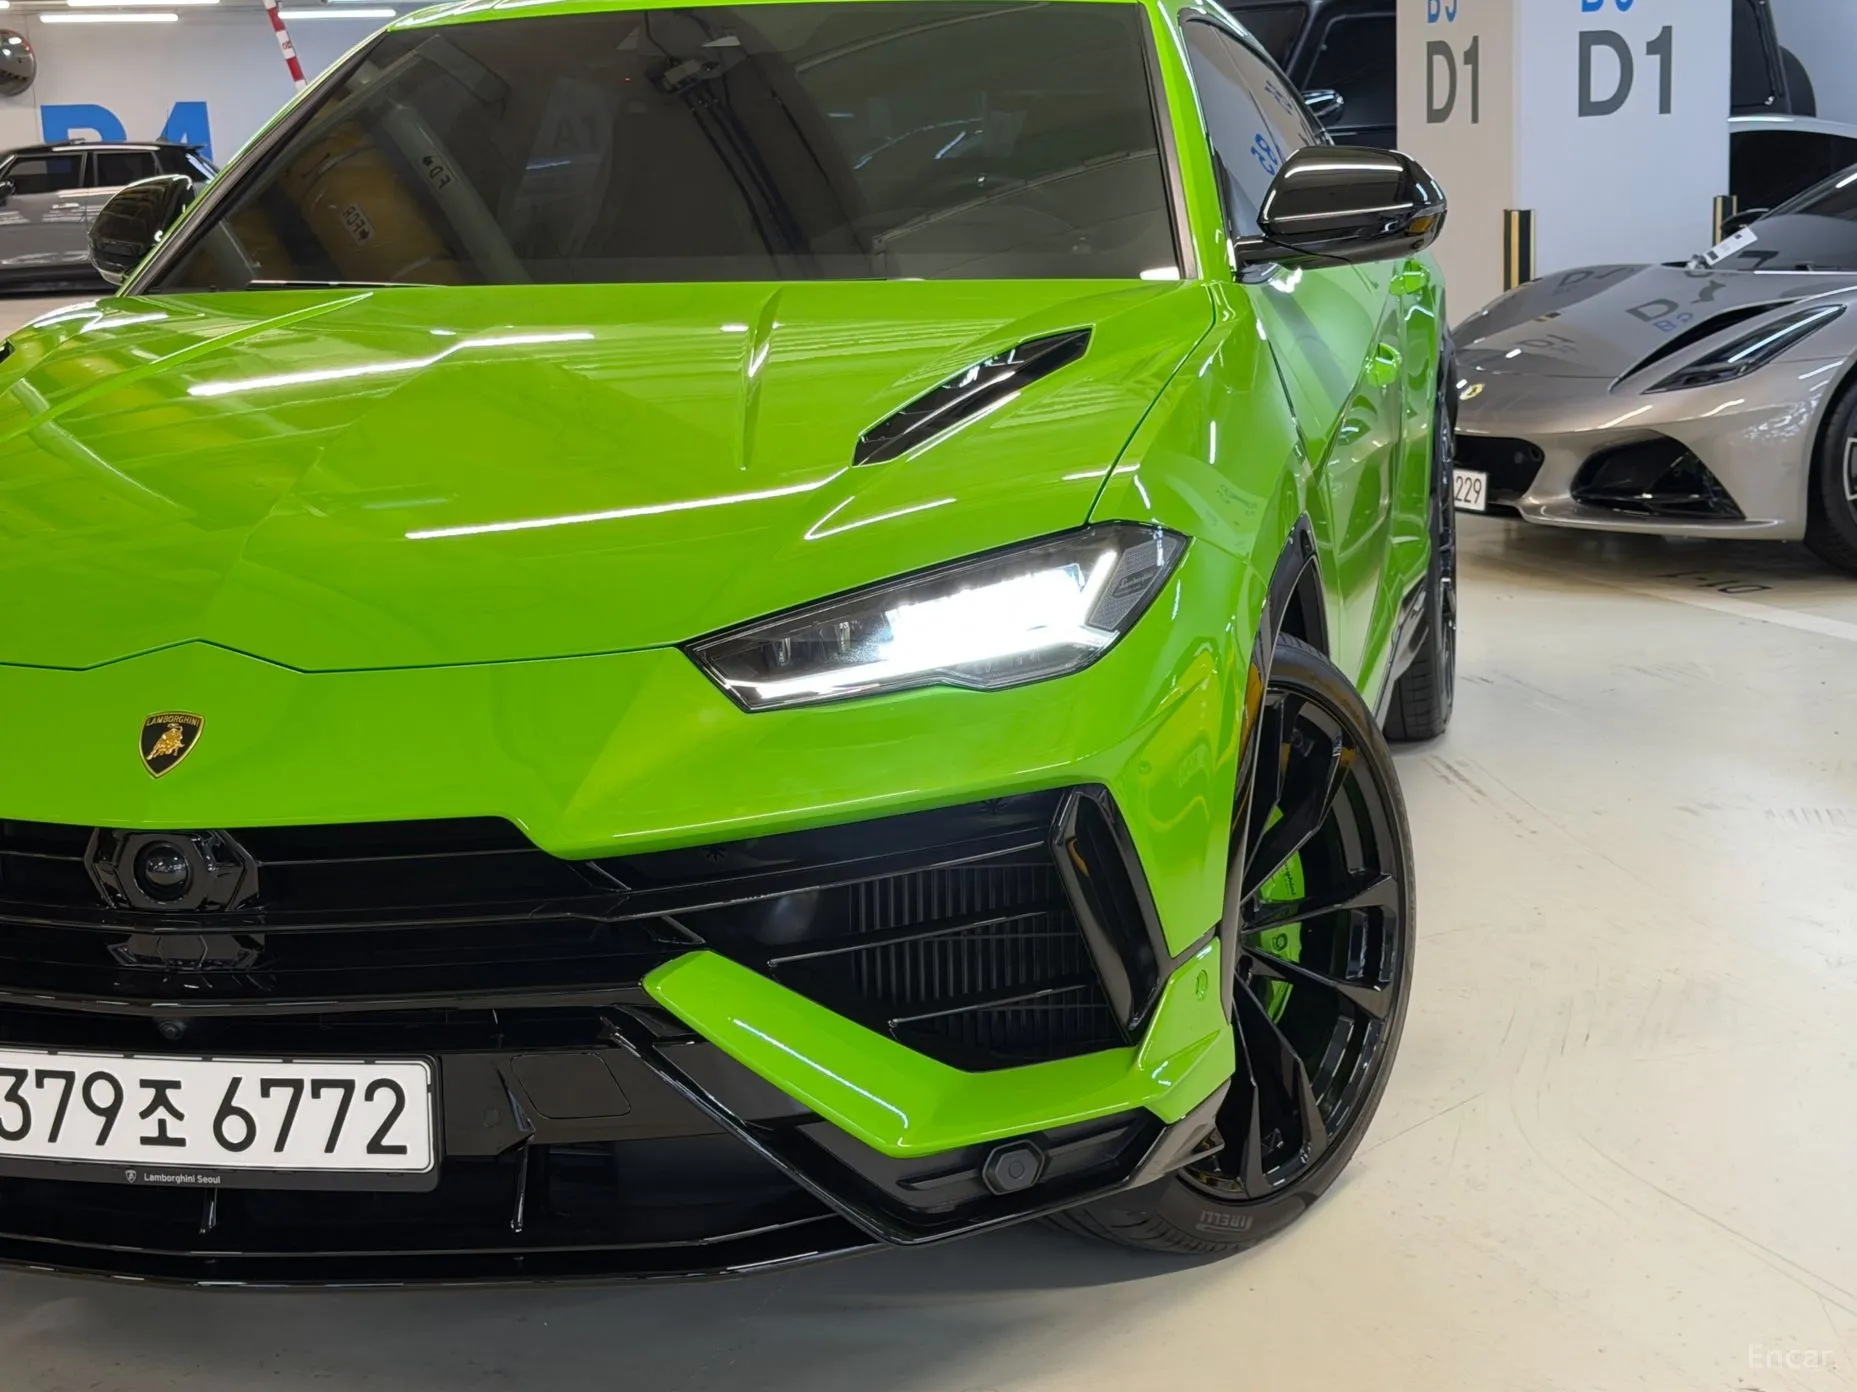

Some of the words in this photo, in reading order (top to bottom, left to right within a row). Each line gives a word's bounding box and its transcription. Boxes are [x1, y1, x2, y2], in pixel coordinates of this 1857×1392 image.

[1426, 35, 1479, 124] D1
[1578, 25, 1672, 117] D1
[1454, 475, 1482, 505] 229
[146, 714, 200, 727] LAMBORGHINI
[0, 1068, 187, 1148] 379조
[212, 1076, 408, 1154] 6772
[143, 1173, 196, 1184] Lamborghini
[197, 1175, 221, 1184] Seoul
[1196, 1209, 1254, 1233] PIRELLI
